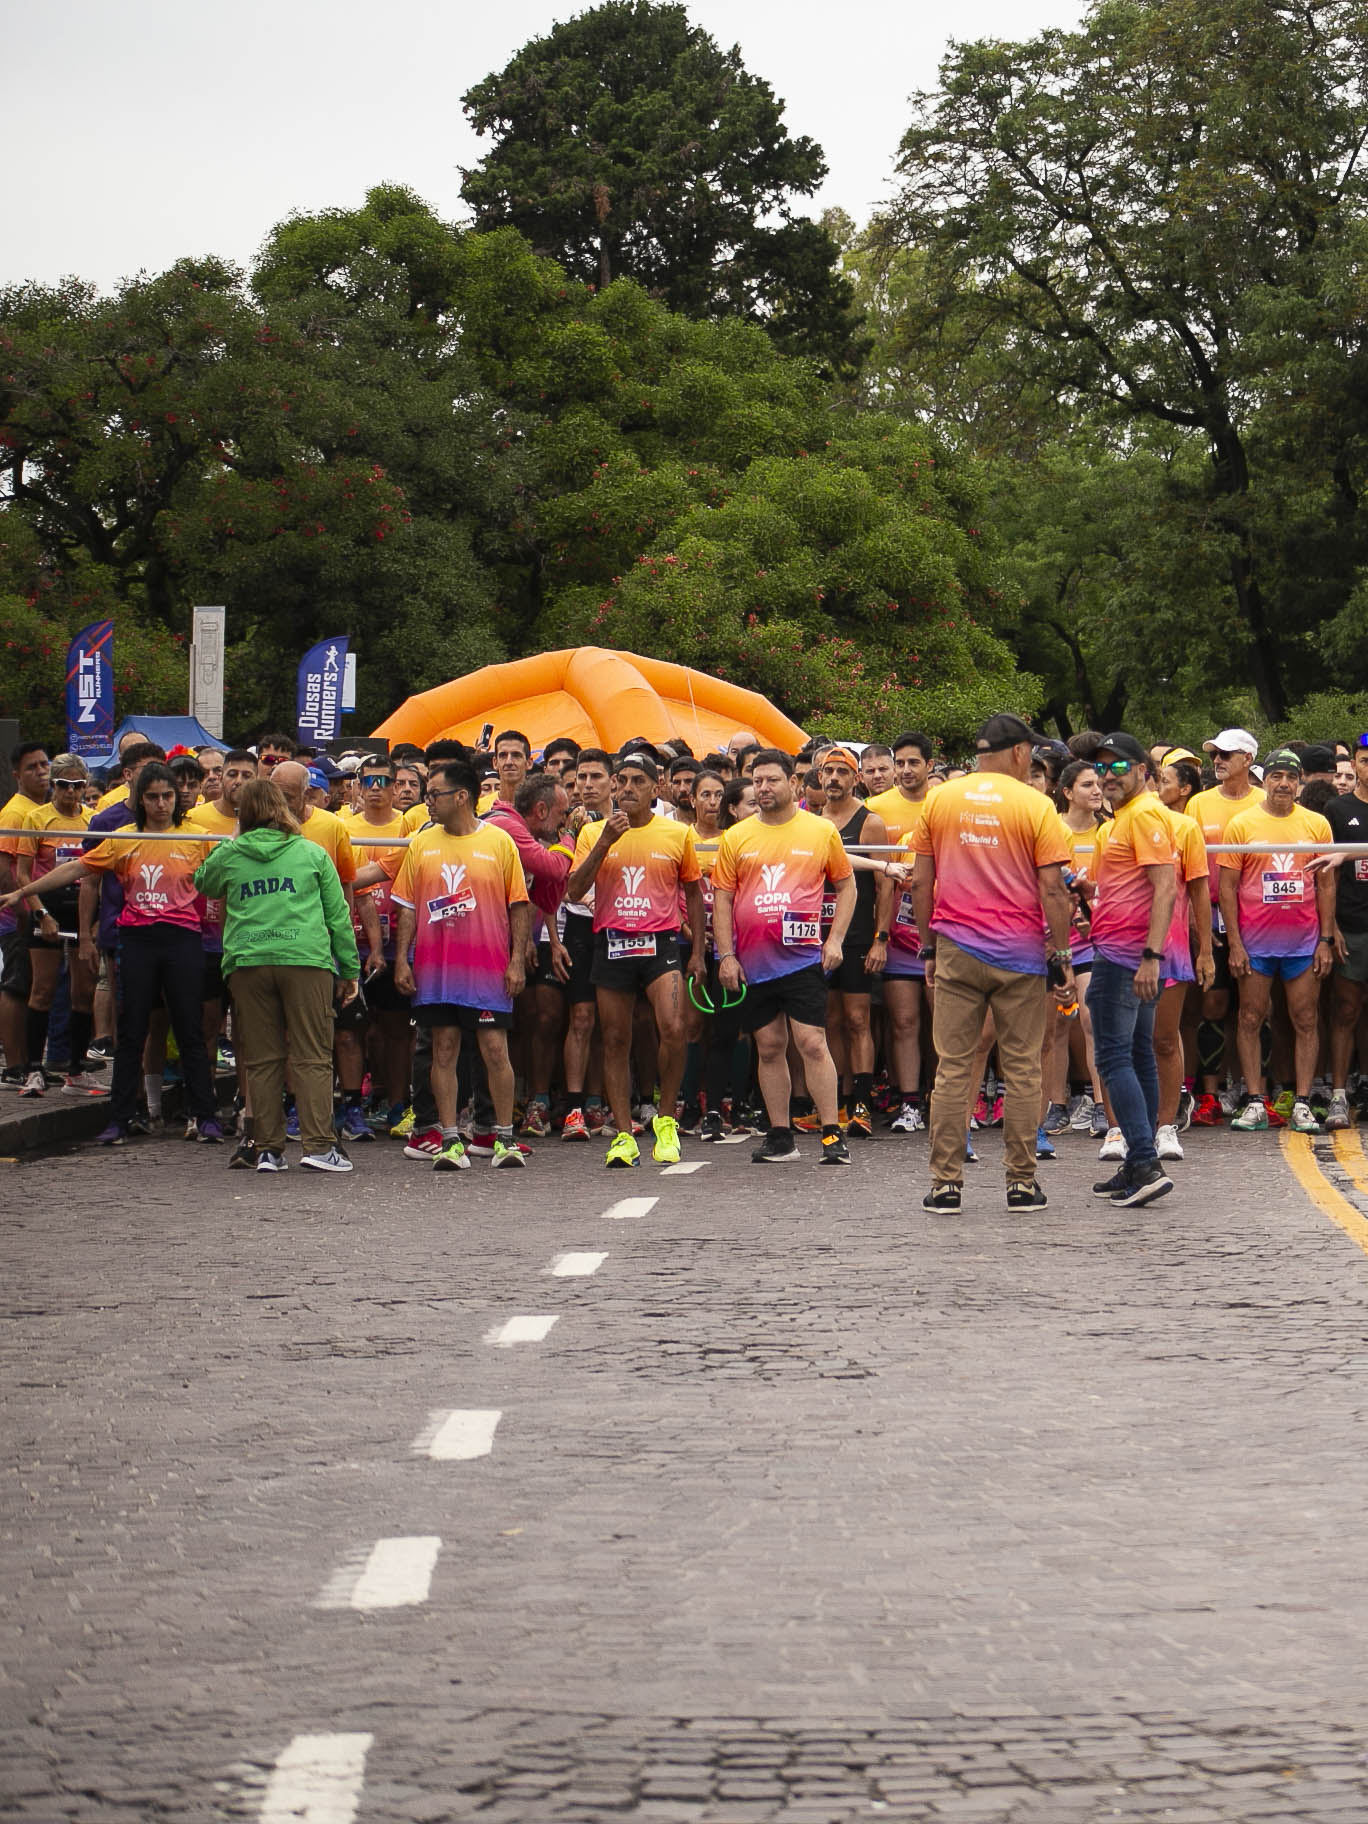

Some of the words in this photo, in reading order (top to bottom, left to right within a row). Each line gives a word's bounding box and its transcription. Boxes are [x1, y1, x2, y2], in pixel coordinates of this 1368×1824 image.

[77, 650, 97, 723] NST
[299, 673, 321, 728] Diosas
[313, 672, 338, 740] Runners
[240, 876, 297, 901] ARDA
[1272, 882, 1297, 894] 845
[136, 892, 169, 904] COPA
[614, 896, 652, 910] COPA
[754, 892, 792, 906] COPA
[617, 909, 638, 917] Santa
[789, 923, 816, 936] 1176
[620, 938, 646, 949] 155
